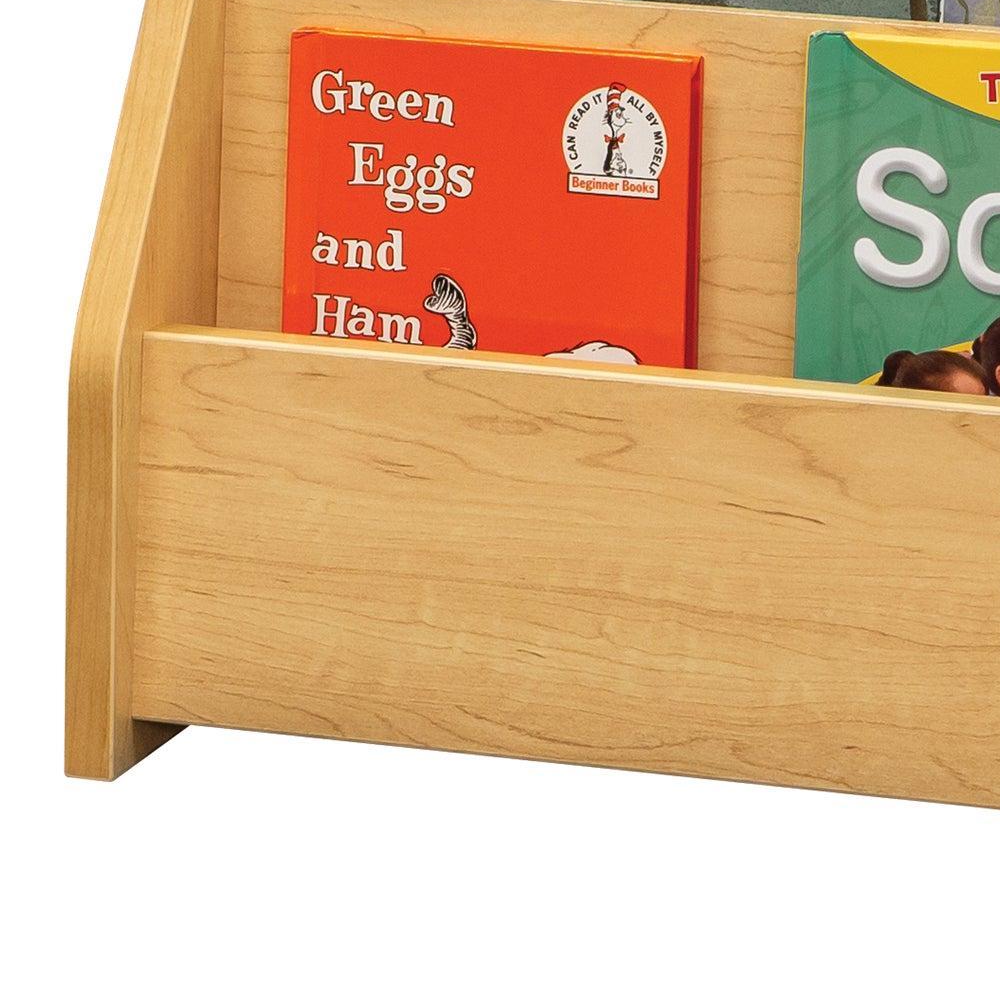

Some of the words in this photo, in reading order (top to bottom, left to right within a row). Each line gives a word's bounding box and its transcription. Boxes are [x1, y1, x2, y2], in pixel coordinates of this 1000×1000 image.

[311, 68, 455, 128] Green
[592, 93, 602, 105] IT
[627, 95, 645, 113] ALL
[568, 101, 591, 130] READ
[645, 111, 659, 127] BY
[567, 135, 578, 160] CAN
[648, 130, 664, 176] MYSELF
[347, 141, 475, 214] Eggs
[571, 176, 620, 192] Beginner
[622, 179, 655, 194] Books
[311, 228, 407, 272] and
[311, 293, 423, 345] Ham
